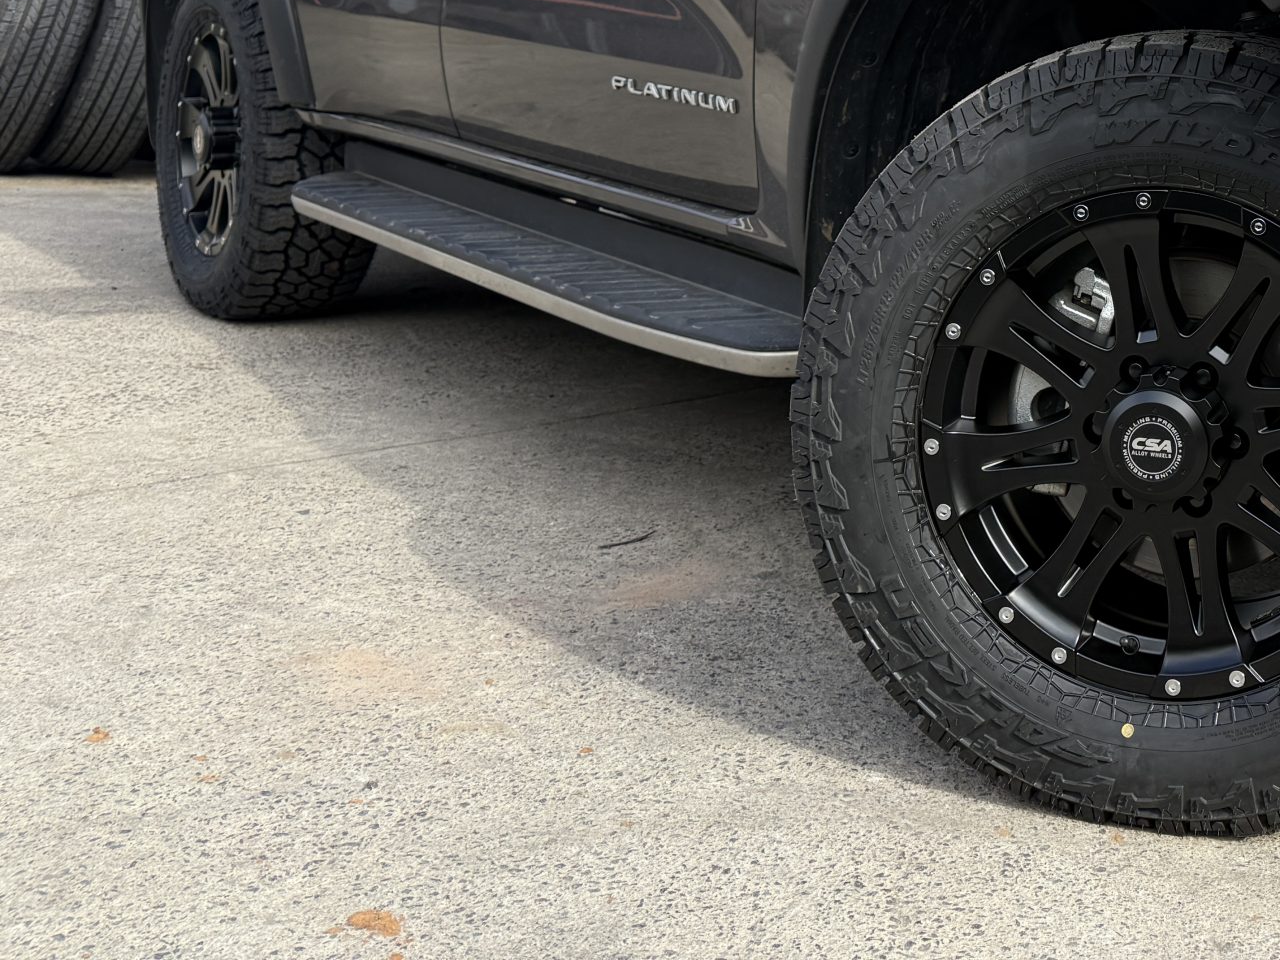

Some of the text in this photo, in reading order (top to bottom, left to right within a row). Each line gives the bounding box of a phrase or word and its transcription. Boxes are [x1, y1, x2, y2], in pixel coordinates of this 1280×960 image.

[611, 74, 738, 115] PLATINUM
[1131, 437, 1173, 454] CSA
[1150, 451, 1172, 459] WHEELS
